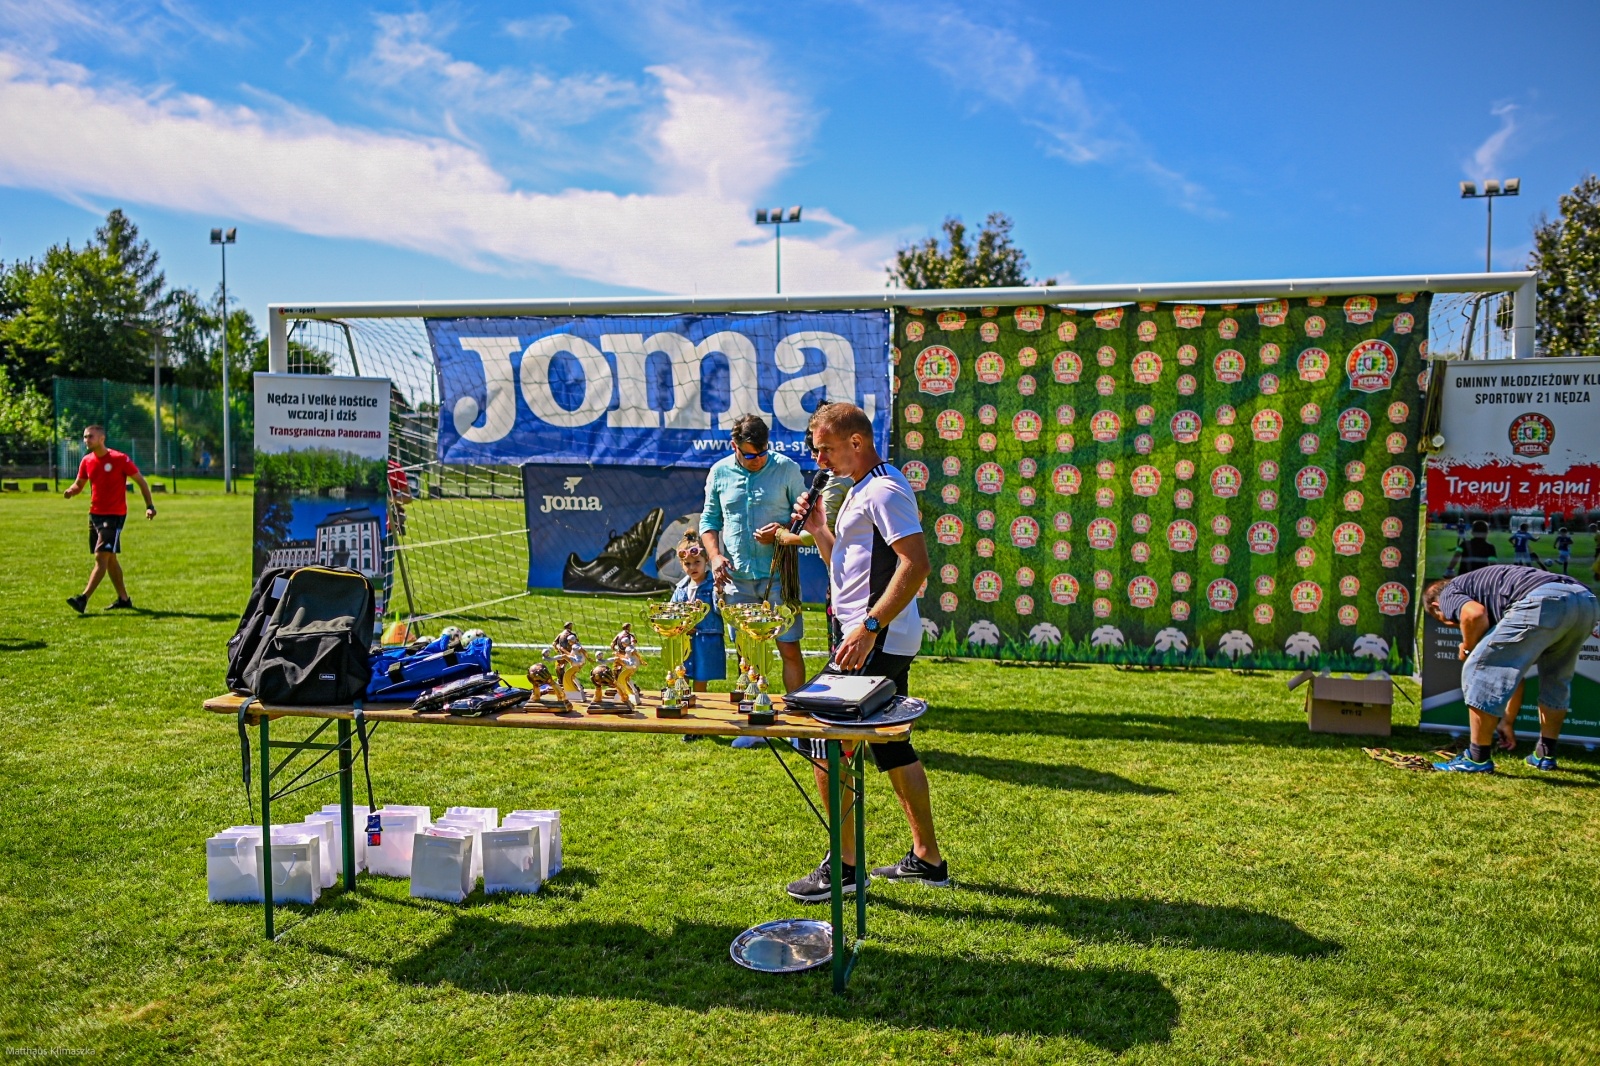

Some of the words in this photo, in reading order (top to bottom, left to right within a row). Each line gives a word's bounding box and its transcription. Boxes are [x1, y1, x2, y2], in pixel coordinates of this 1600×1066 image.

[453, 330, 876, 444] Joma
[1455, 376, 1498, 388] GMINNY
[1501, 373, 1580, 387] MŁODZIEŻOWY
[267, 393, 299, 406] Nędza
[301, 393, 305, 405] i
[308, 394, 337, 406] Velké
[1475, 392, 1533, 404] SPORTOWY
[1536, 392, 1550, 403] 21
[1554, 391, 1591, 405] NĘDZA
[288, 409, 328, 422] wczoraj
[330, 409, 334, 420] i
[336, 409, 357, 421] dziś
[269, 426, 336, 438] Transgraniczna
[338, 428, 381, 439] Panorama
[1445, 475, 1512, 502] Trenuj
[1518, 481, 1530, 493] z
[1538, 478, 1591, 495] nami
[540, 495, 603, 513] Joma
